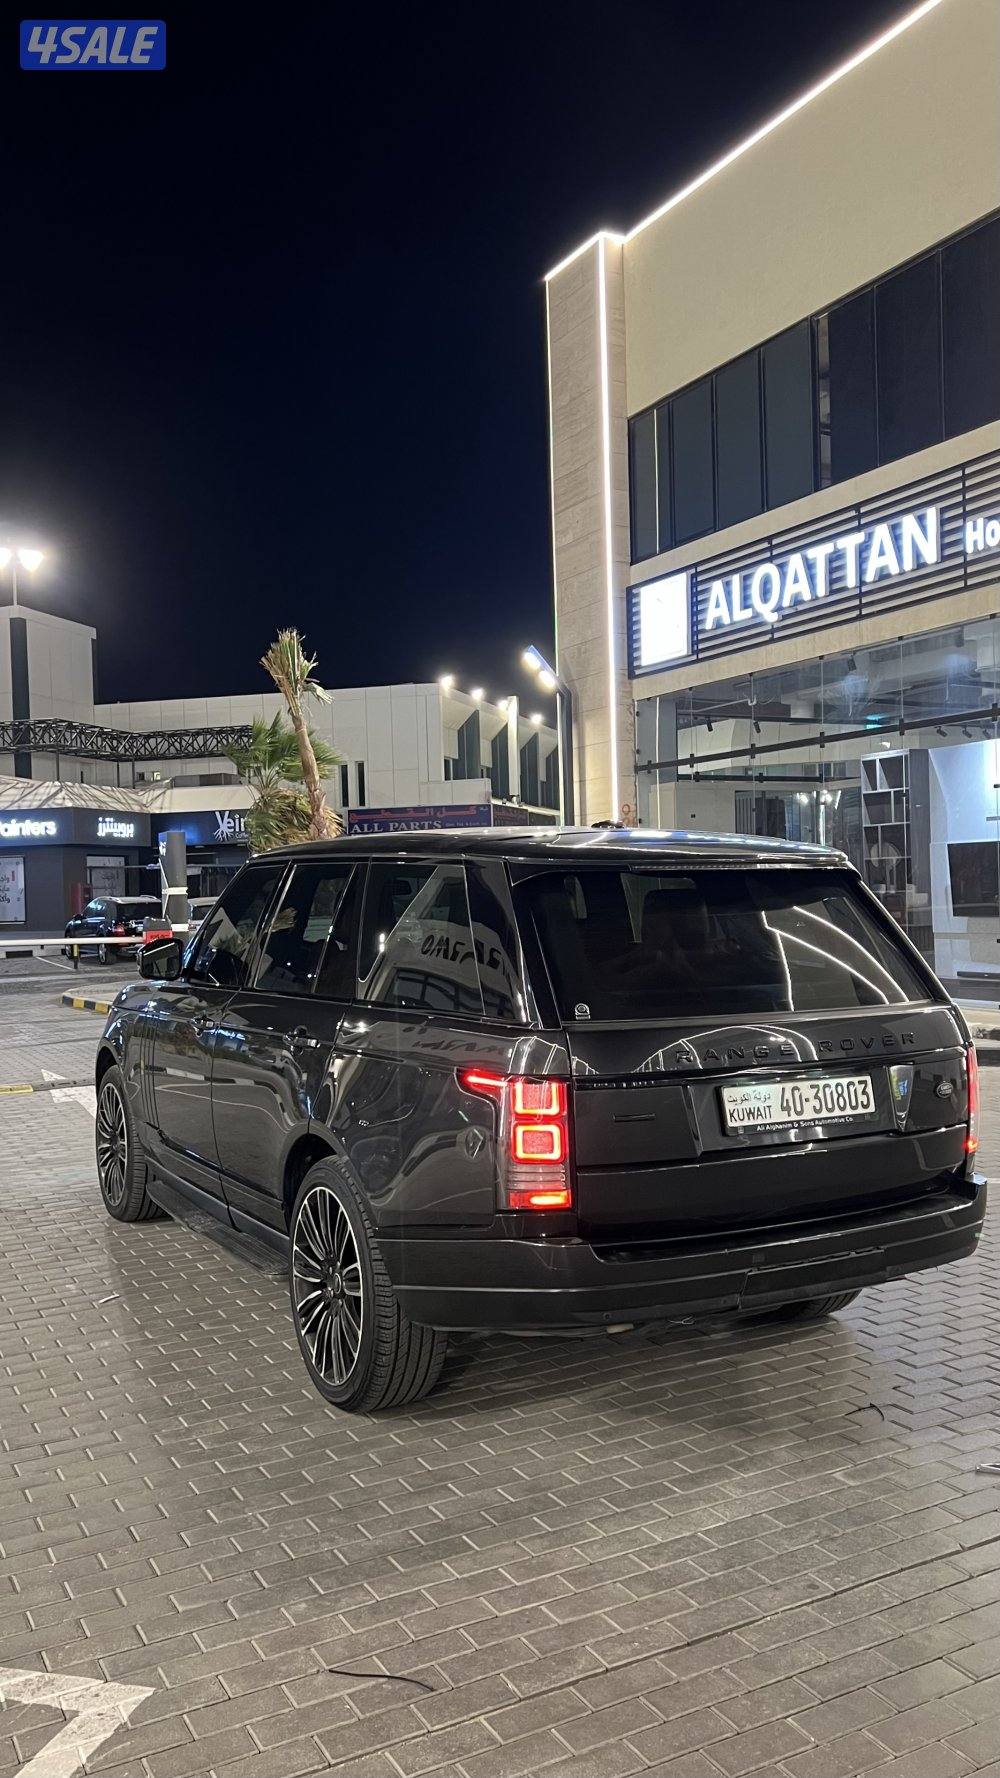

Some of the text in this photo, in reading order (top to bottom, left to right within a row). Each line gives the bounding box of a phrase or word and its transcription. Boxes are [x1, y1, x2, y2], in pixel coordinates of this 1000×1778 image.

[705, 506, 939, 630] ALQATTAN
[0, 819, 57, 837] ainters
[350, 822, 384, 834] ALL
[389, 820, 442, 832] PARTS
[676, 1032, 916, 1064] RANGE ROVER
[727, 1092, 752, 1106] الكويت
[780, 1079, 871, 1118] 40-30803
[728, 1105, 772, 1123] KUWAIT
[815, 1117, 845, 1125] Automotive
